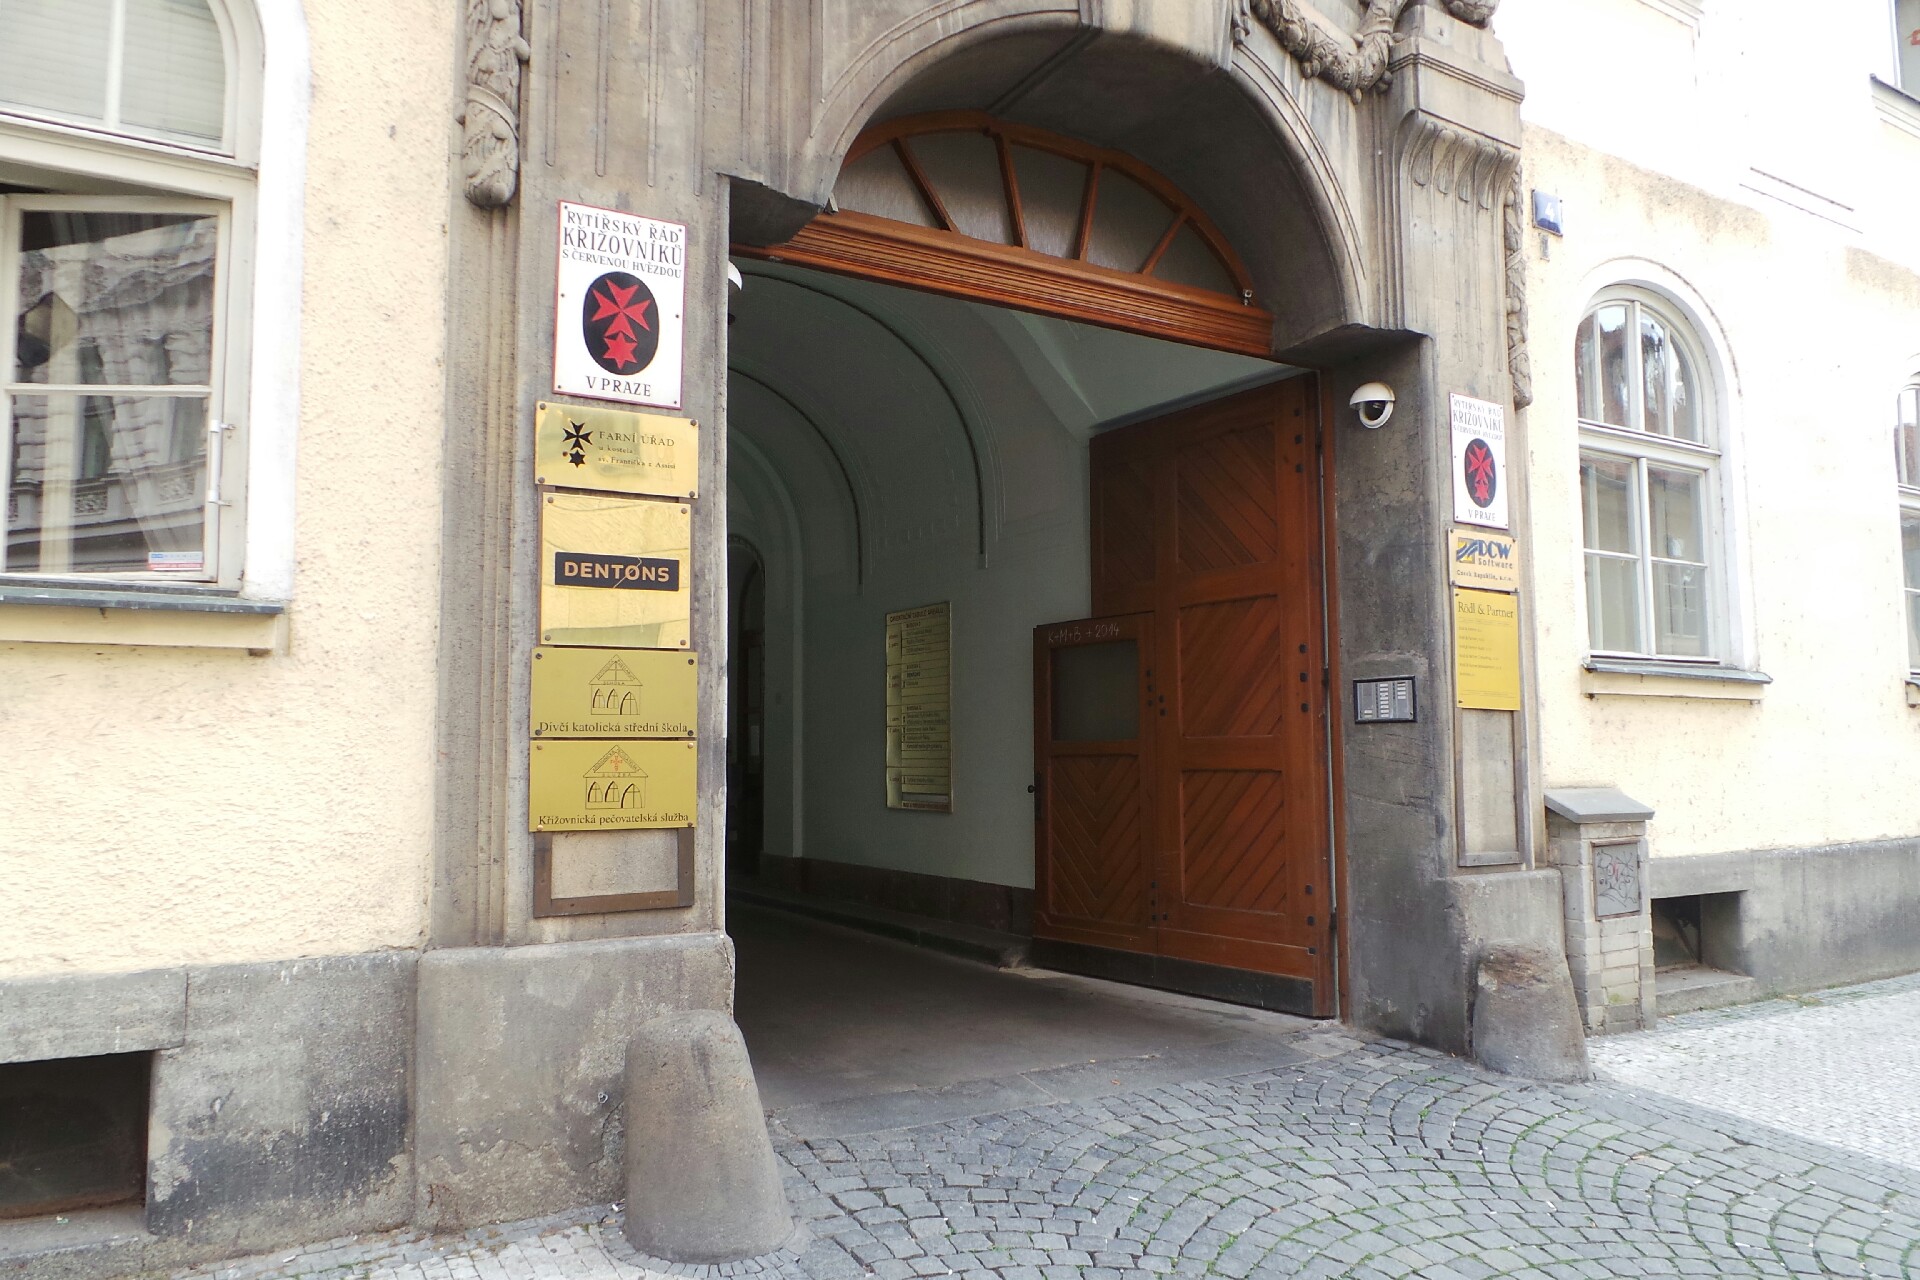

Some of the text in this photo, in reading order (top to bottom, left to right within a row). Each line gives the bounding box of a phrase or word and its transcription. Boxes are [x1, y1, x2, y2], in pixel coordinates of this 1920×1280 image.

[1545, 202, 1555, 221] 4
[566, 210, 679, 244] RYTÍŘSKÝ ŘÁD
[563, 226, 682, 266] KŘIŽOVNÍKŮ
[562, 248, 682, 278] S ČERVENOU HVĚZDOU
[586, 376, 651, 397] V PRAZE
[599, 431, 675, 446] FARNÍ ÚŘAD
[607, 445, 633, 454] kostela
[611, 456, 646, 466] Františka
[1478, 540, 1512, 560] DCW
[1478, 558, 1513, 569] Software
[1458, 602, 1514, 618] Rödl & Partner
[539, 721, 688, 732] Dívčí katolická střední škola
[600, 813, 658, 826] pečovatelská
[660, 812, 689, 823] služba
